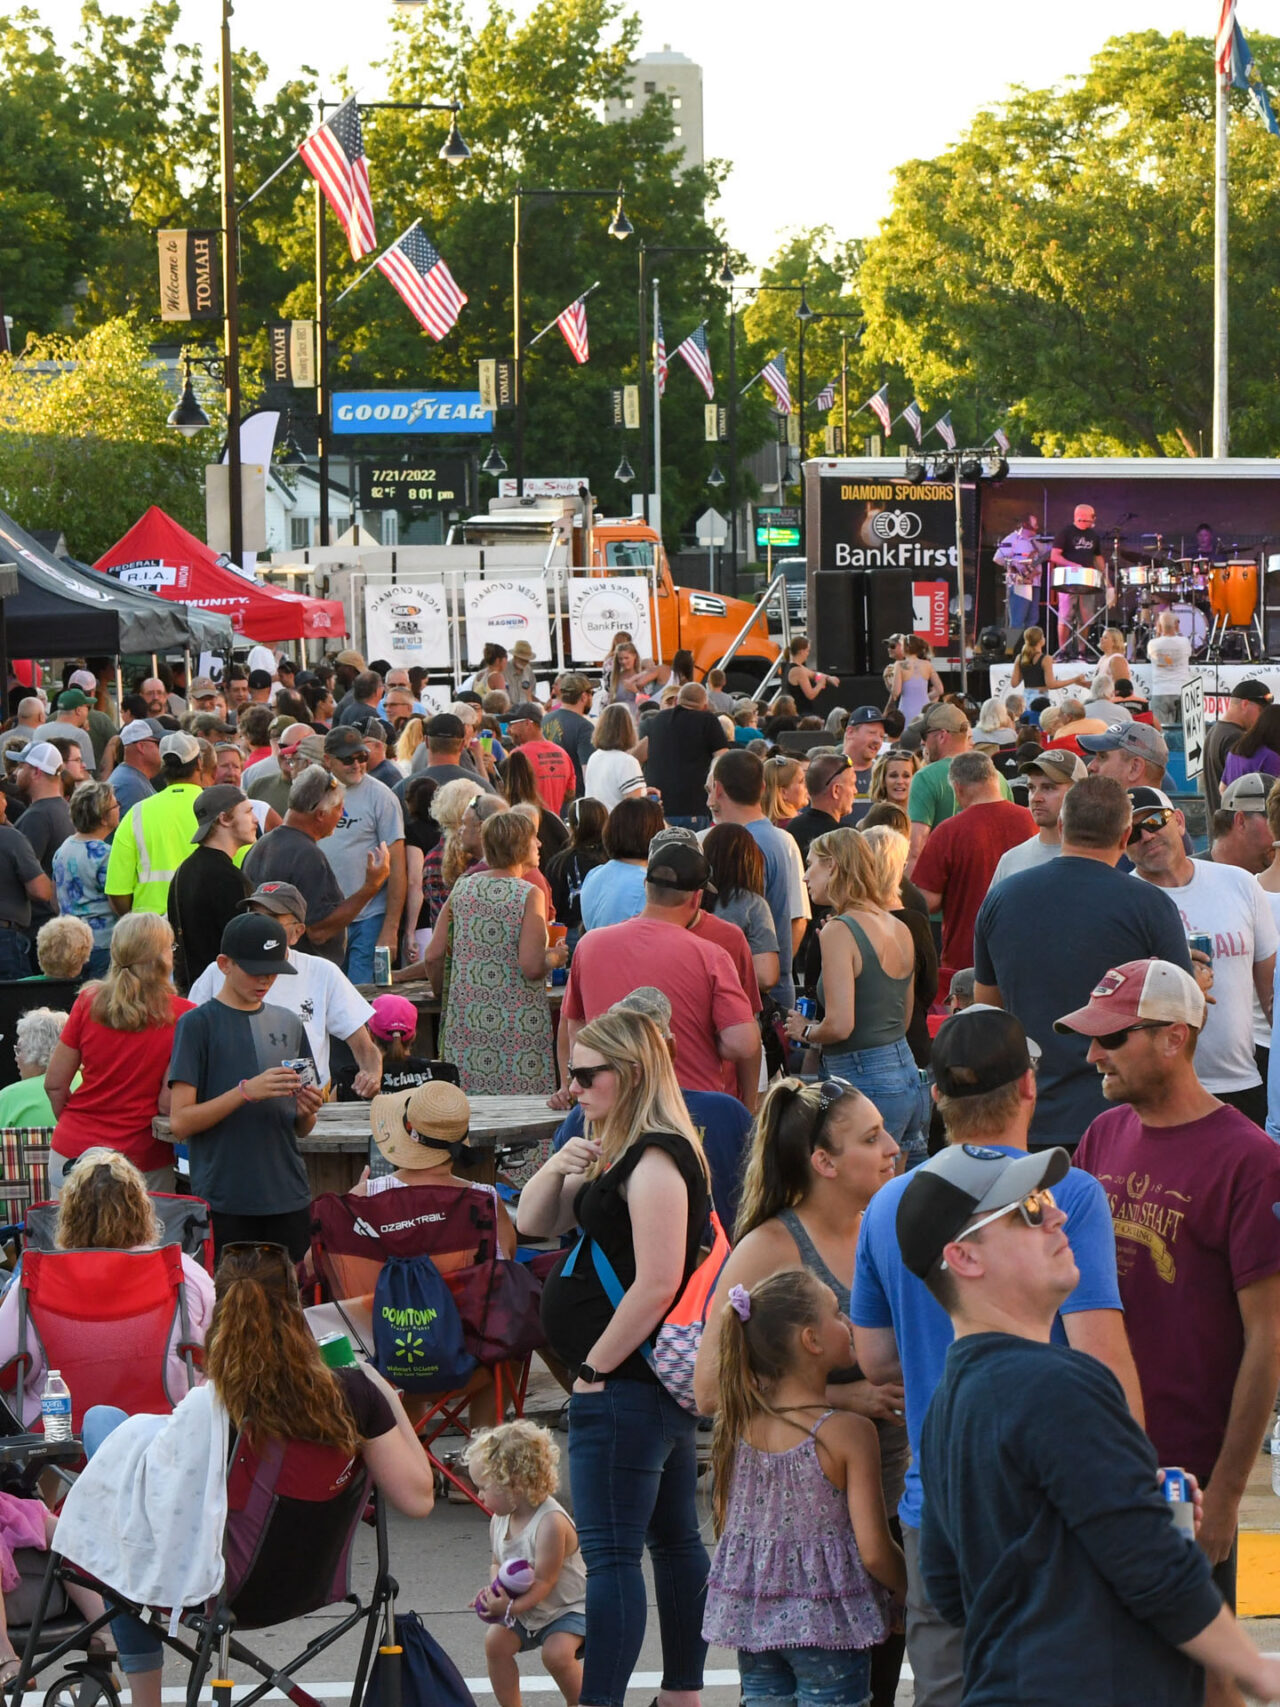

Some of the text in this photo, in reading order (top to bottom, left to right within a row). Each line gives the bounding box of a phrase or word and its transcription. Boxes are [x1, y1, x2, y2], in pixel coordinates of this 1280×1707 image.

[163, 240, 181, 312] Welcome to
[194, 238, 212, 311] TOMAH
[274, 328, 287, 381] TOMAH
[499, 363, 509, 405] TOMAH
[337, 403, 487, 421] GOODYEAR
[613, 390, 621, 424] TOMAH
[372, 469, 436, 481] 7/21/2022
[437, 490, 454, 501] pm
[841, 485, 953, 500] DIAMOND SPONSORS
[108, 559, 158, 573] FEDERAL
[836, 543, 959, 567] BankFirst
[127, 571, 169, 582] R.I.A.
[175, 596, 251, 608] MMUNITY.
[371, 587, 413, 612] DIAMOND
[417, 589, 441, 614] MEDIA
[471, 583, 542, 610] DIAMOND MEDIA
[572, 584, 646, 619] TITANIUM SPONSOR
[488, 619, 525, 627] MAGNUM
[587, 621, 634, 631] BankFirst
[934, 591, 945, 637] UNION
[1185, 687, 1202, 713] ONE
[1204, 697, 1232, 713] ODAY
[1185, 712, 1202, 737] WAY
[1211, 931, 1249, 960] ALL
[1117, 1201, 1184, 1243] AND SHAFT
[382, 1306, 437, 1327] DOWNTOWN
